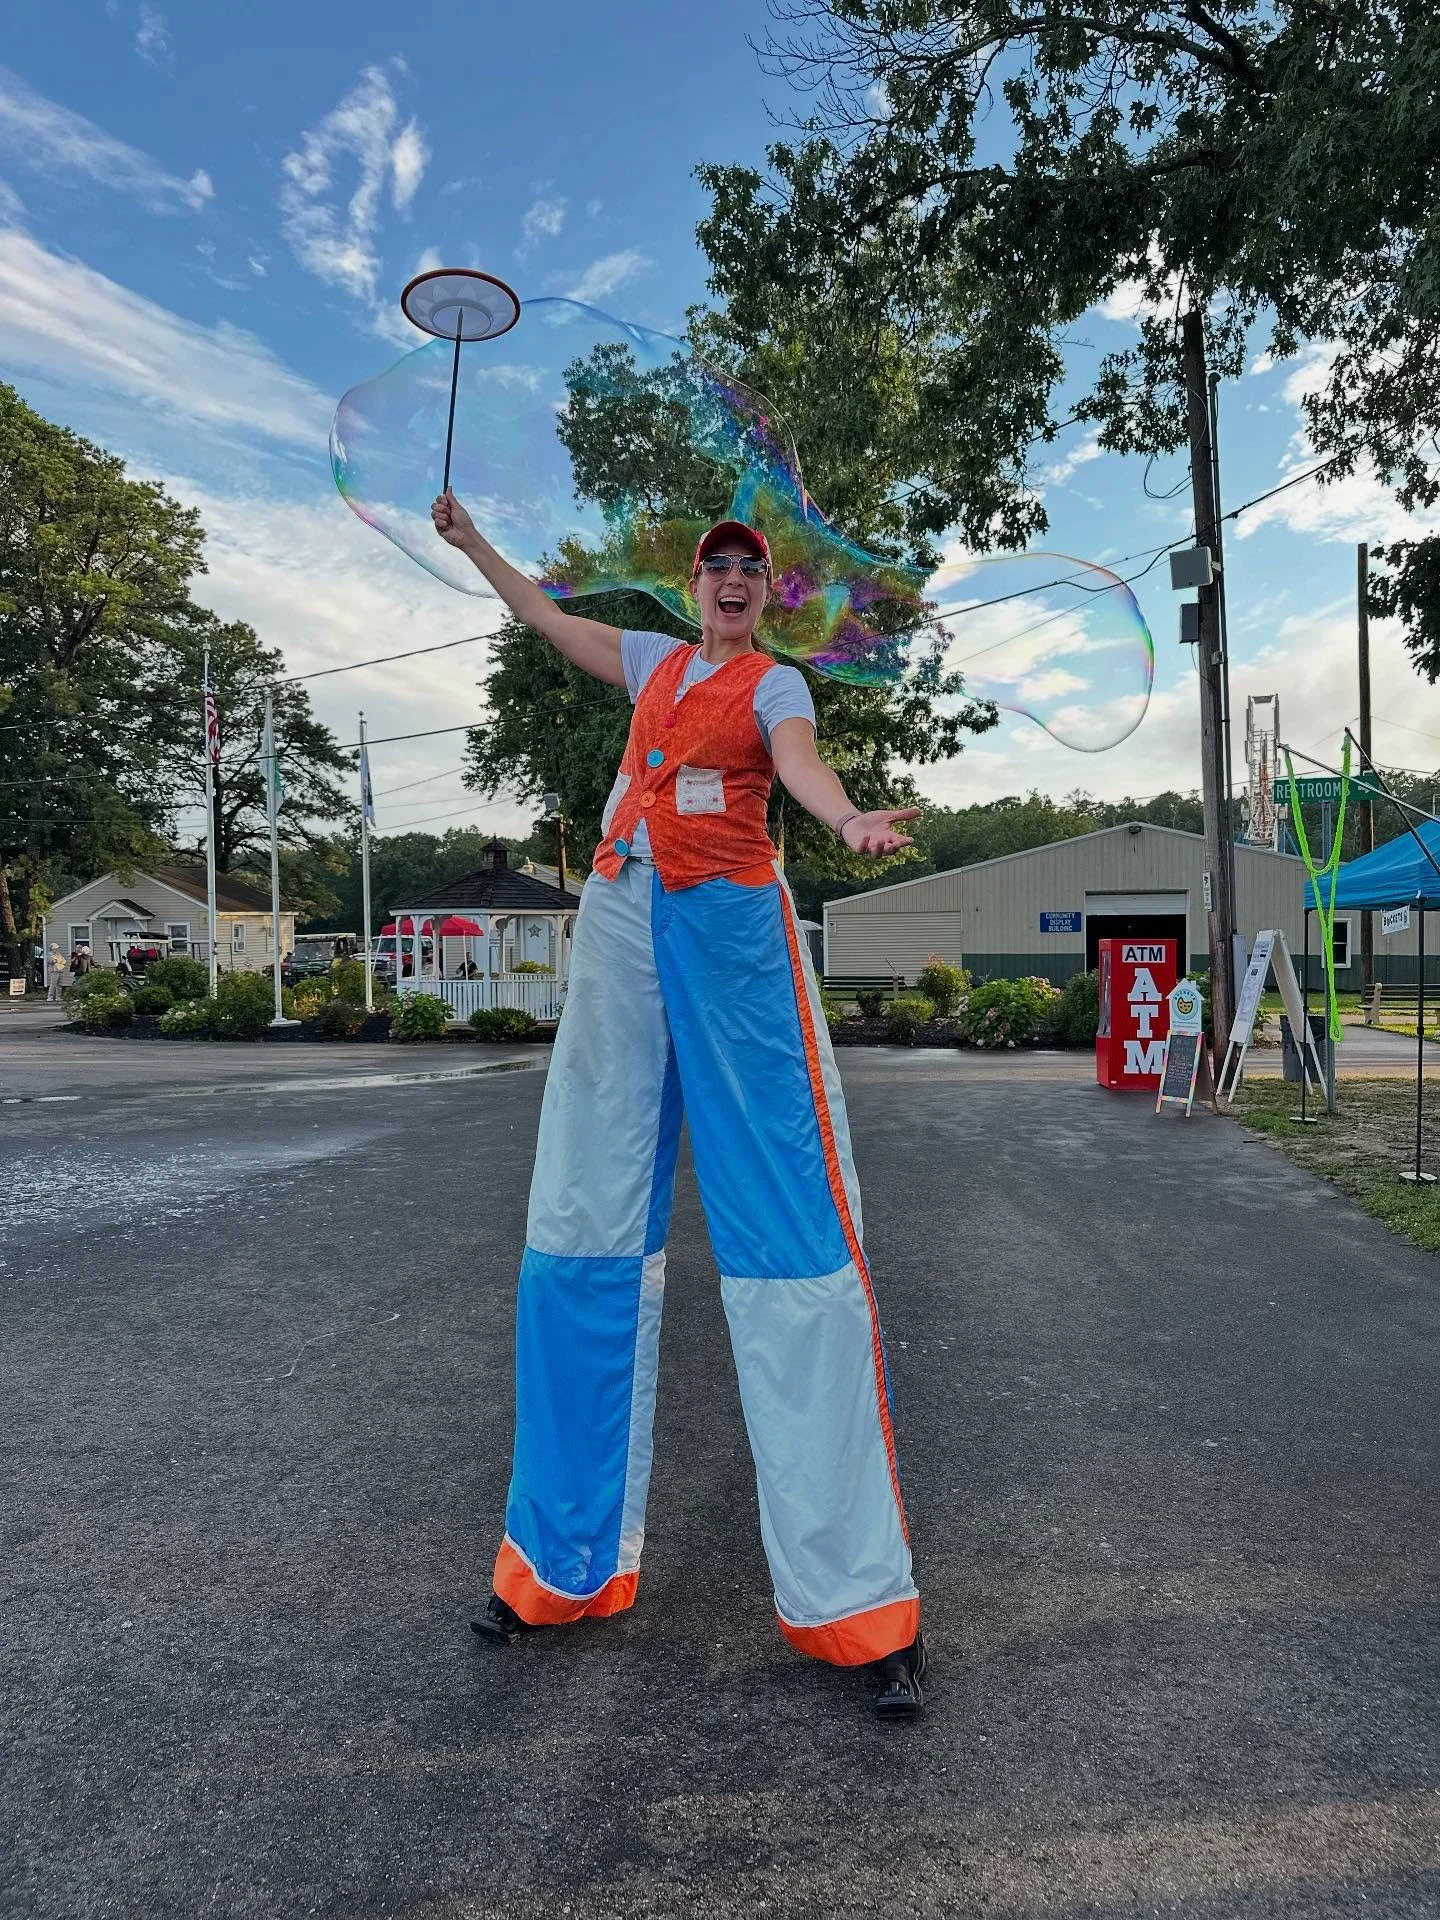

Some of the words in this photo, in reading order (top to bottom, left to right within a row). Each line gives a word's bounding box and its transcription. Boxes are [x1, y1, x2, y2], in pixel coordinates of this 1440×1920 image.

[1276, 781, 1350, 800] RETROOM
[1125, 946, 1163, 962] ATM
[1124, 967, 1166, 1075] ATM
